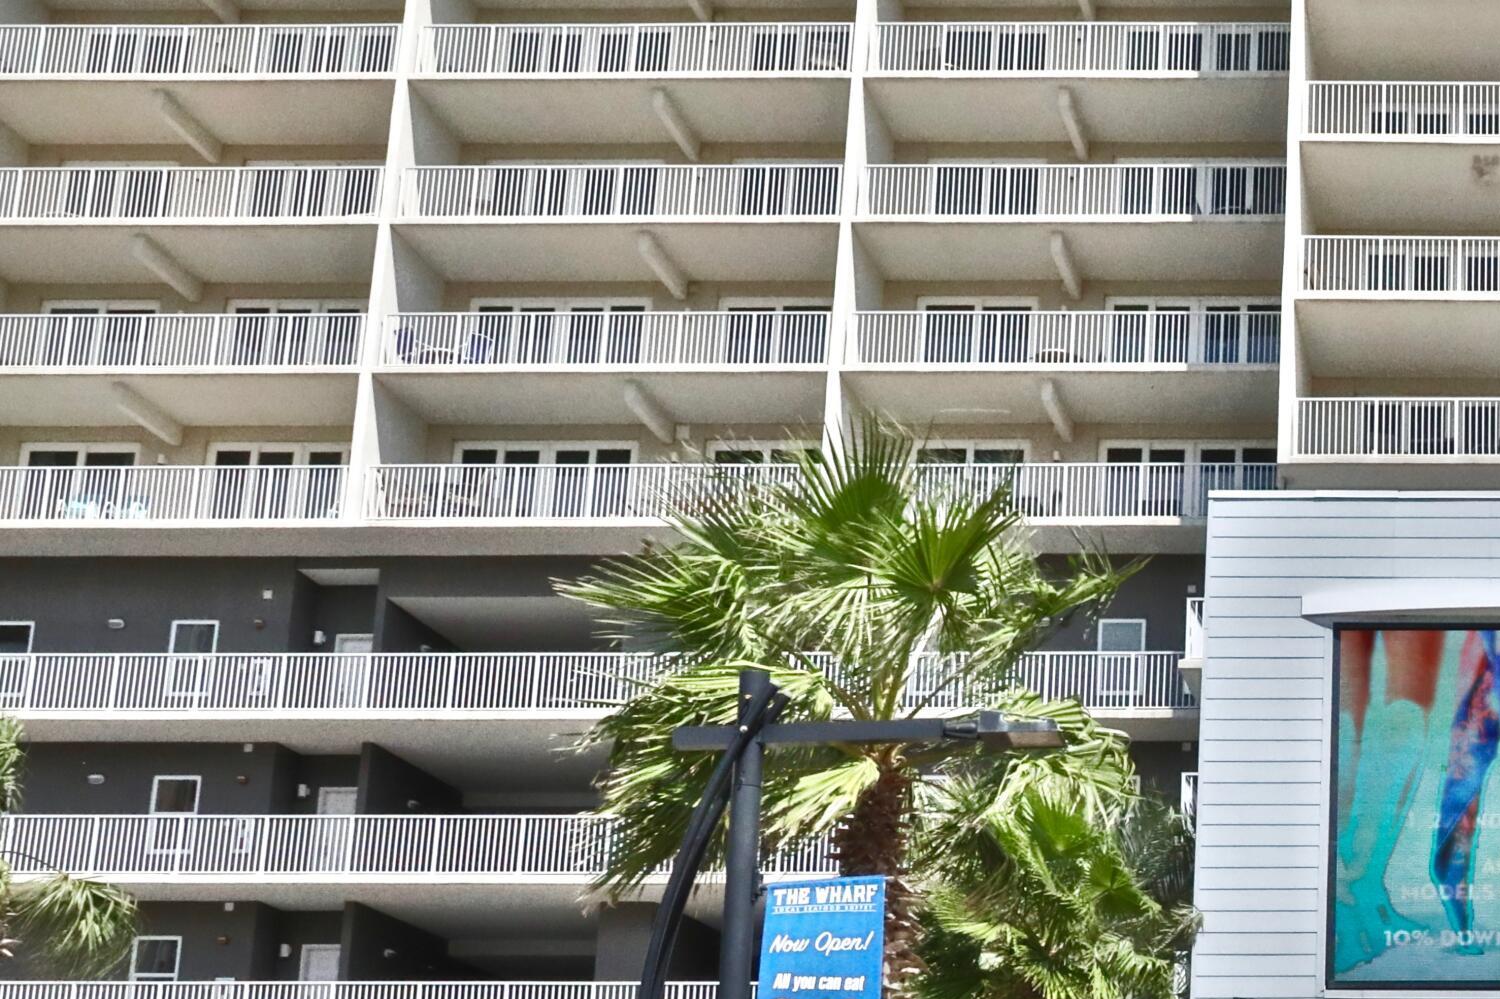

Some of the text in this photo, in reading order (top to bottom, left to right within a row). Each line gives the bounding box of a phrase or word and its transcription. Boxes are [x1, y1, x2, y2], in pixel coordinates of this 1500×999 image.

[773, 884, 878, 906] THE WHARF
[769, 930, 875, 956] Now Open!
[1384, 930, 1434, 946] 10%
[772, 973, 866, 993] All you can eat
